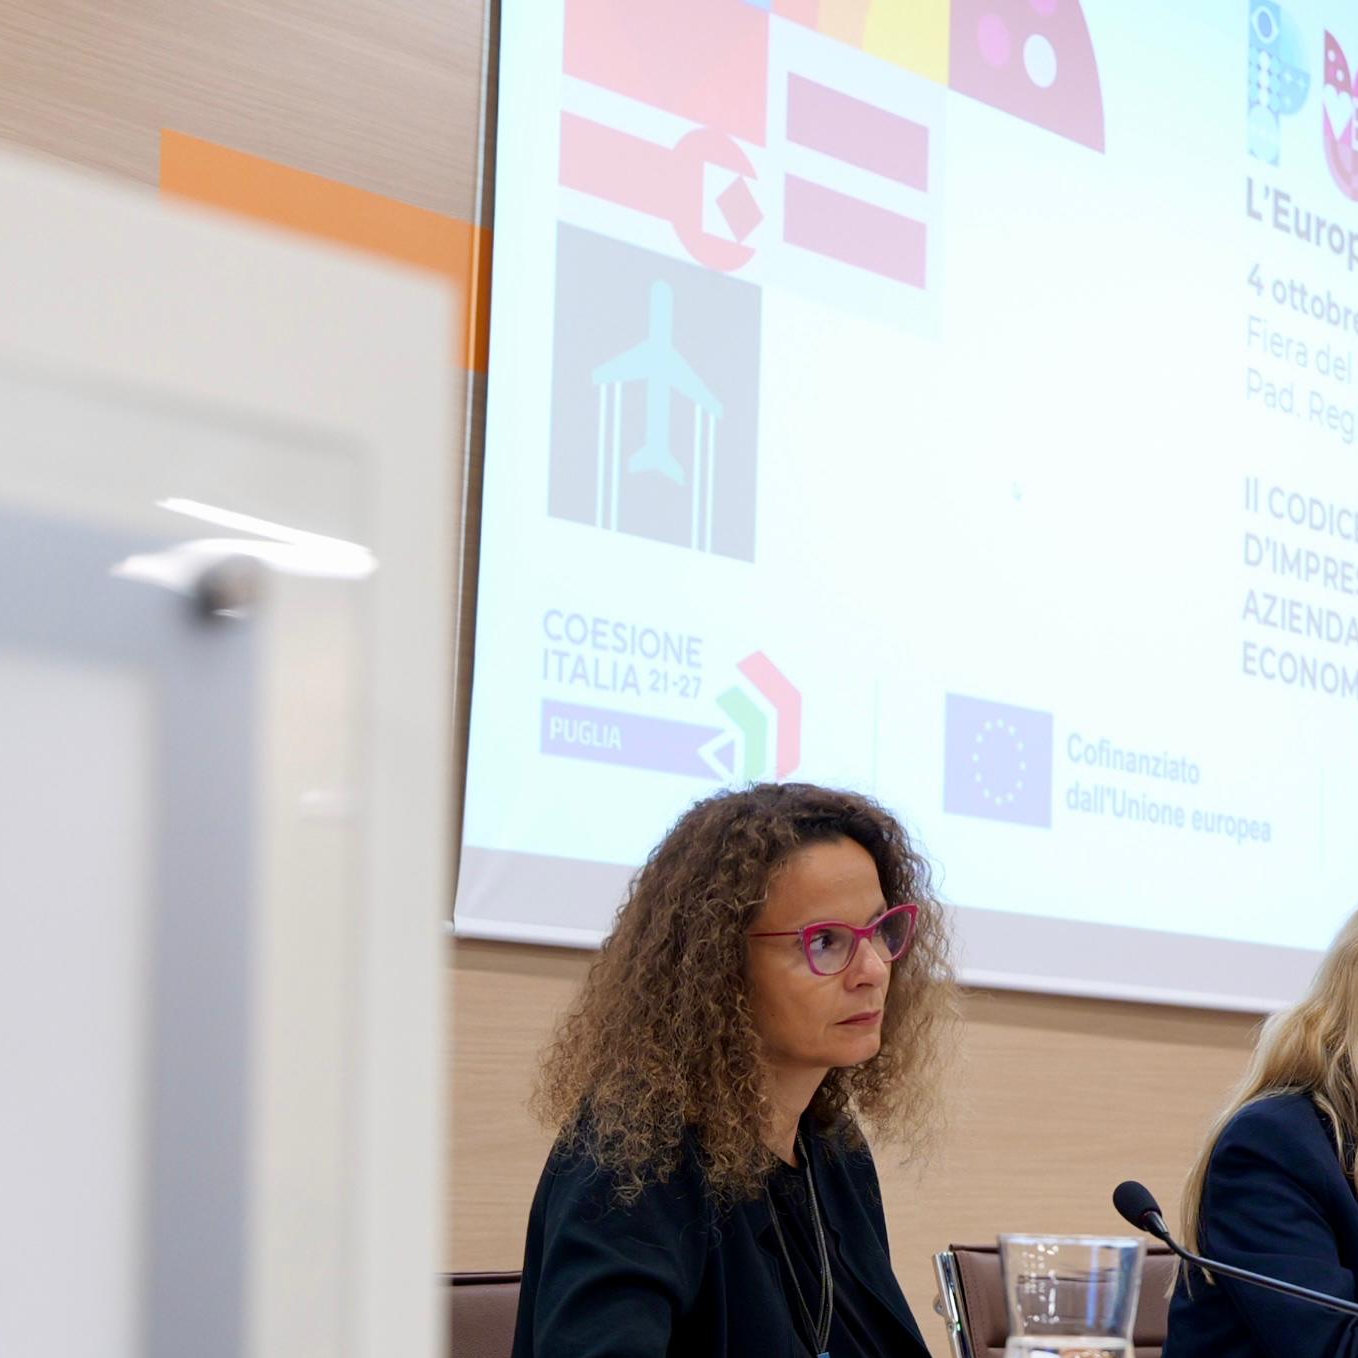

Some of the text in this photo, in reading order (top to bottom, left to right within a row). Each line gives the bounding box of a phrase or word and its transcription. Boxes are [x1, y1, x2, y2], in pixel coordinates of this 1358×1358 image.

[1247, 263, 1265, 297] 4
[1247, 314, 1309, 369] Fiera
[1315, 343, 1352, 386] del
[1246, 366, 1302, 420] Pad.
[543, 608, 703, 669] COESIONE
[542, 647, 703, 700] ITALIA 21-27
[549, 715, 623, 751] PUGLIA
[1066, 732, 1201, 785] Cofinanziato
[1065, 780, 1272, 846] dall'Unione europea
